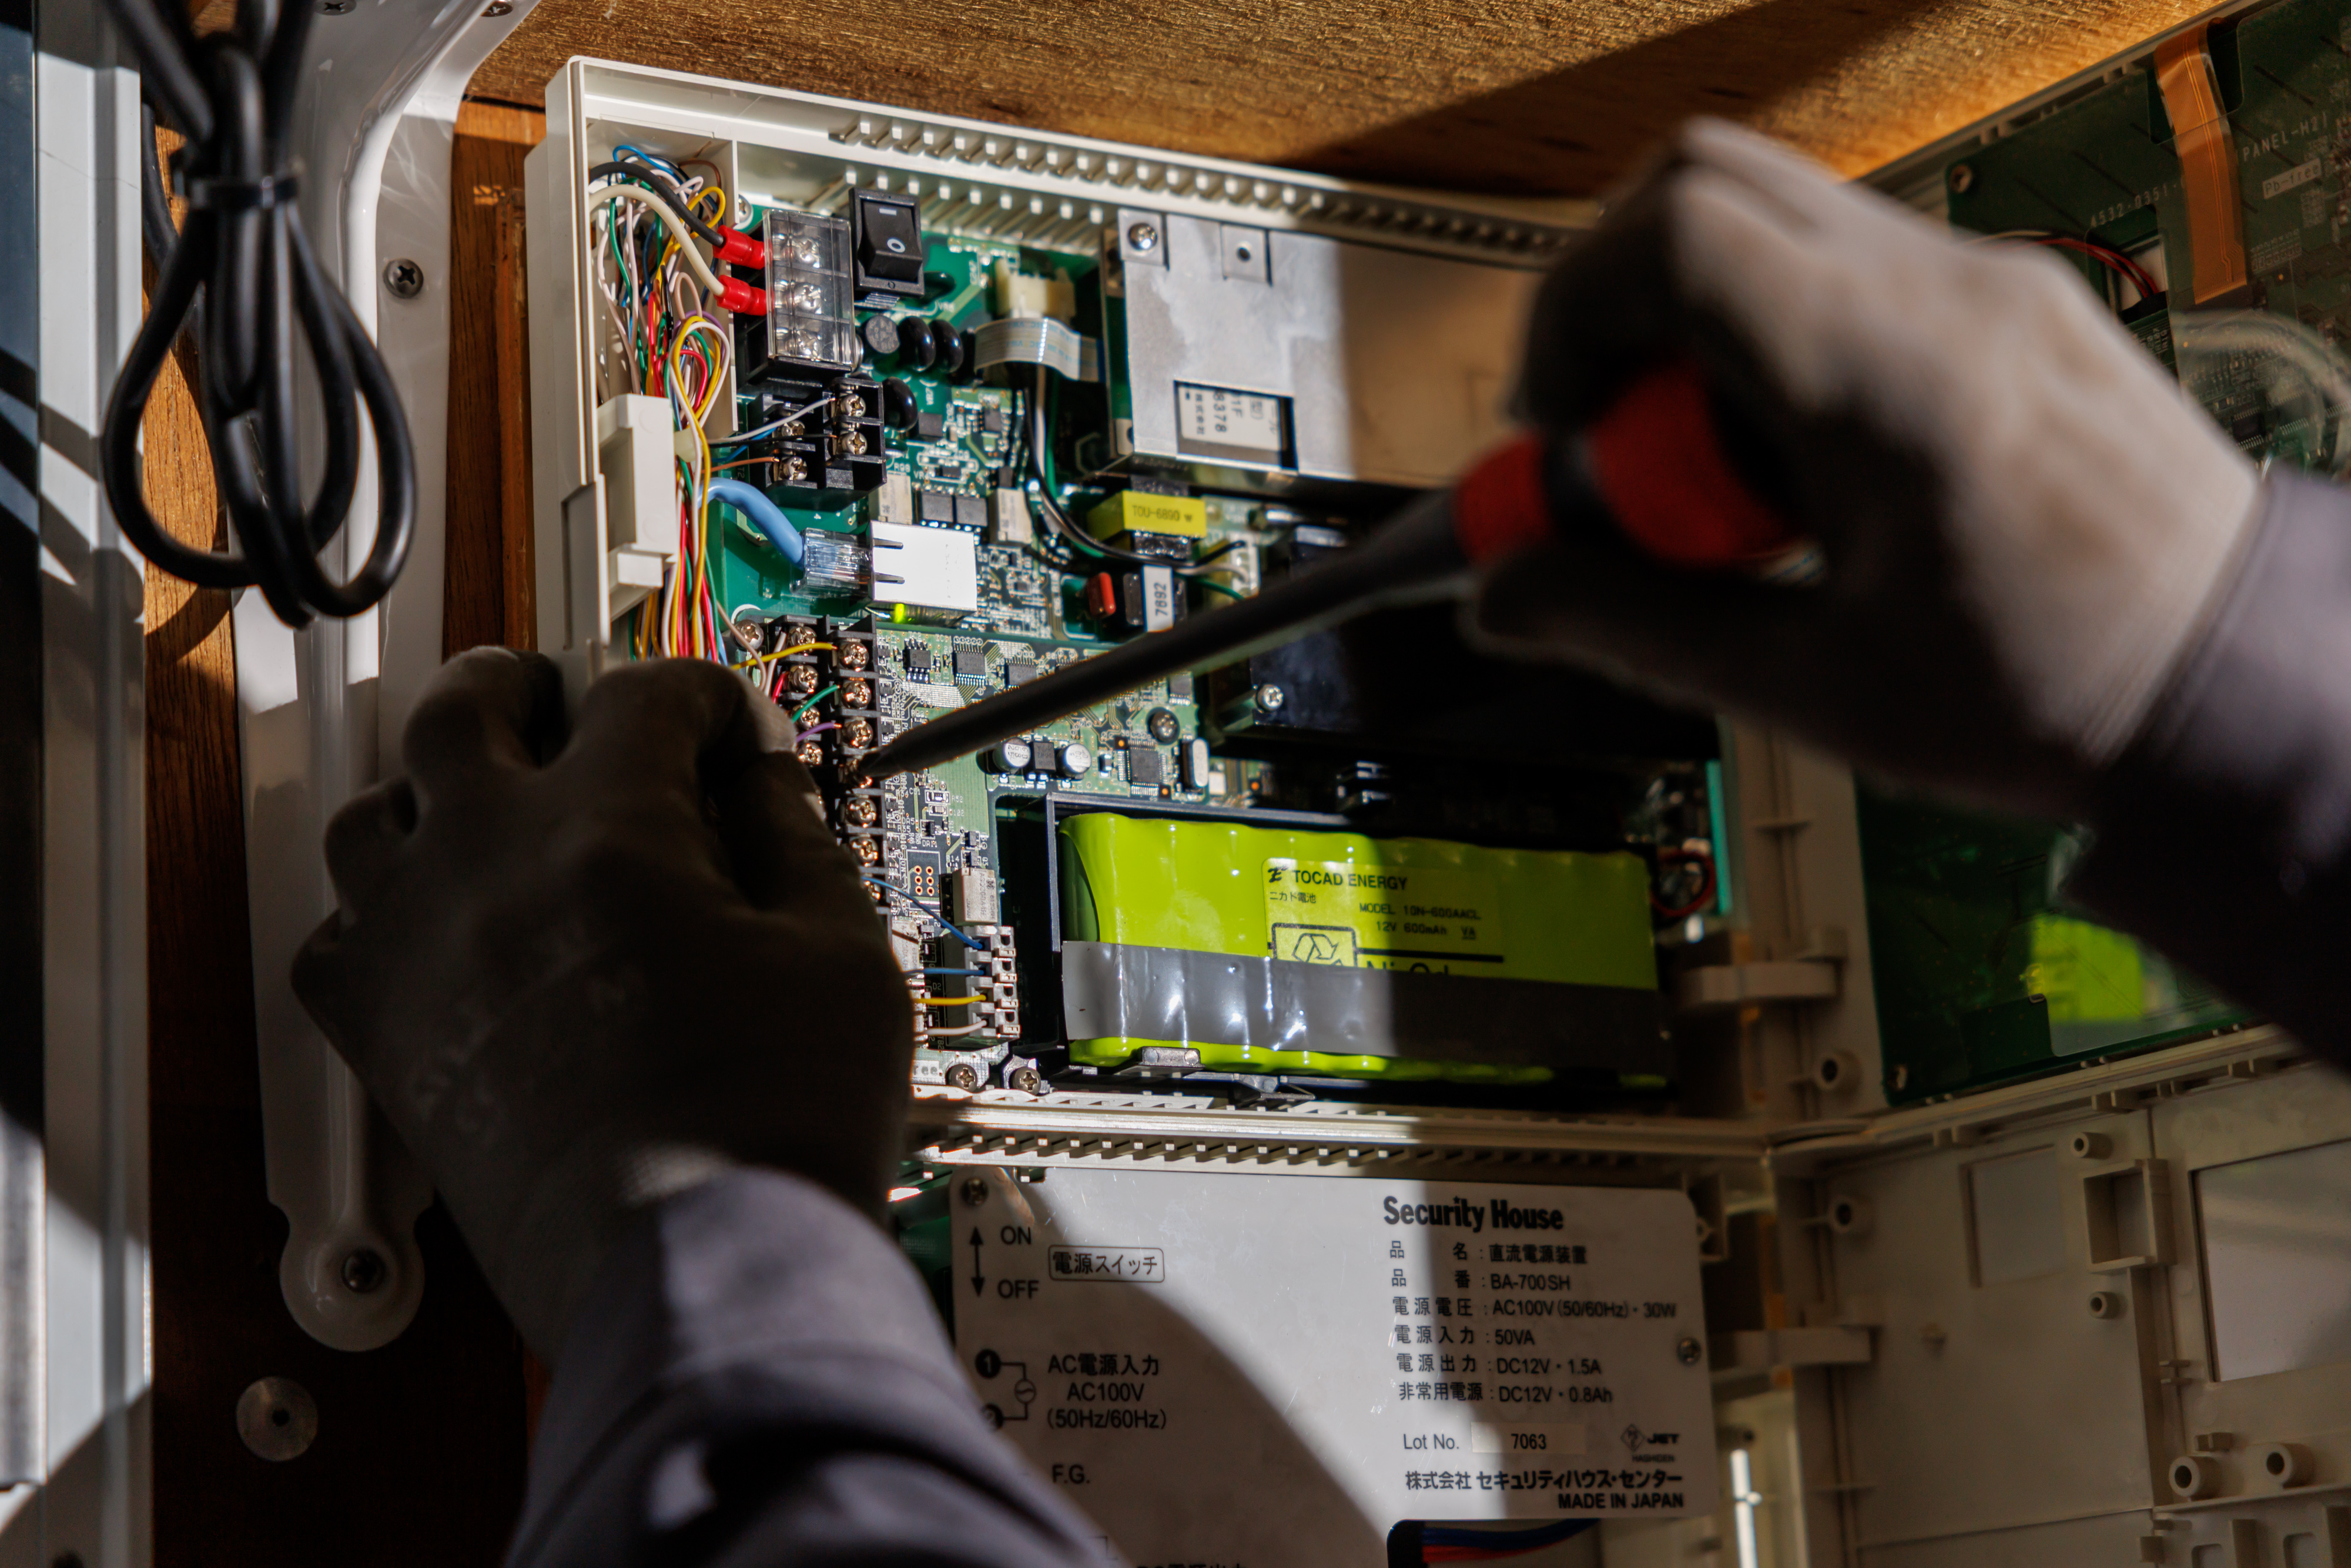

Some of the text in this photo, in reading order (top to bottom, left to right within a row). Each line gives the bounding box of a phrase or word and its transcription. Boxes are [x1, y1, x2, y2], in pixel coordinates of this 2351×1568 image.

[1293, 869, 1344, 886] TOCAD
[1348, 873, 1408, 891] ENERGY
[1269, 890, 1317, 905] ニカド電池
[1359, 902, 1395, 915] MODEL
[1376, 920, 1396, 933] 12V
[1404, 923, 1447, 936] 600mAh
[1383, 1195, 1564, 1233] Security House
[1001, 1226, 1032, 1245] ON
[1053, 1252, 1158, 1275] 電源スイッチ
[997, 1280, 1040, 1299] OFF
[1047, 1353, 1160, 1378] AC電源入力
[1066, 1382, 1145, 1403] AC100V
[1047, 1409, 1167, 1430] (50Hz/60Hz)
[1403, 1433, 1547, 1450] Lot No. 7063
[1051, 1465, 1091, 1485] F.G.
[1405, 1470, 1472, 1490] 株式会社
[1558, 1493, 1684, 1510] MADE IN JAPAN
